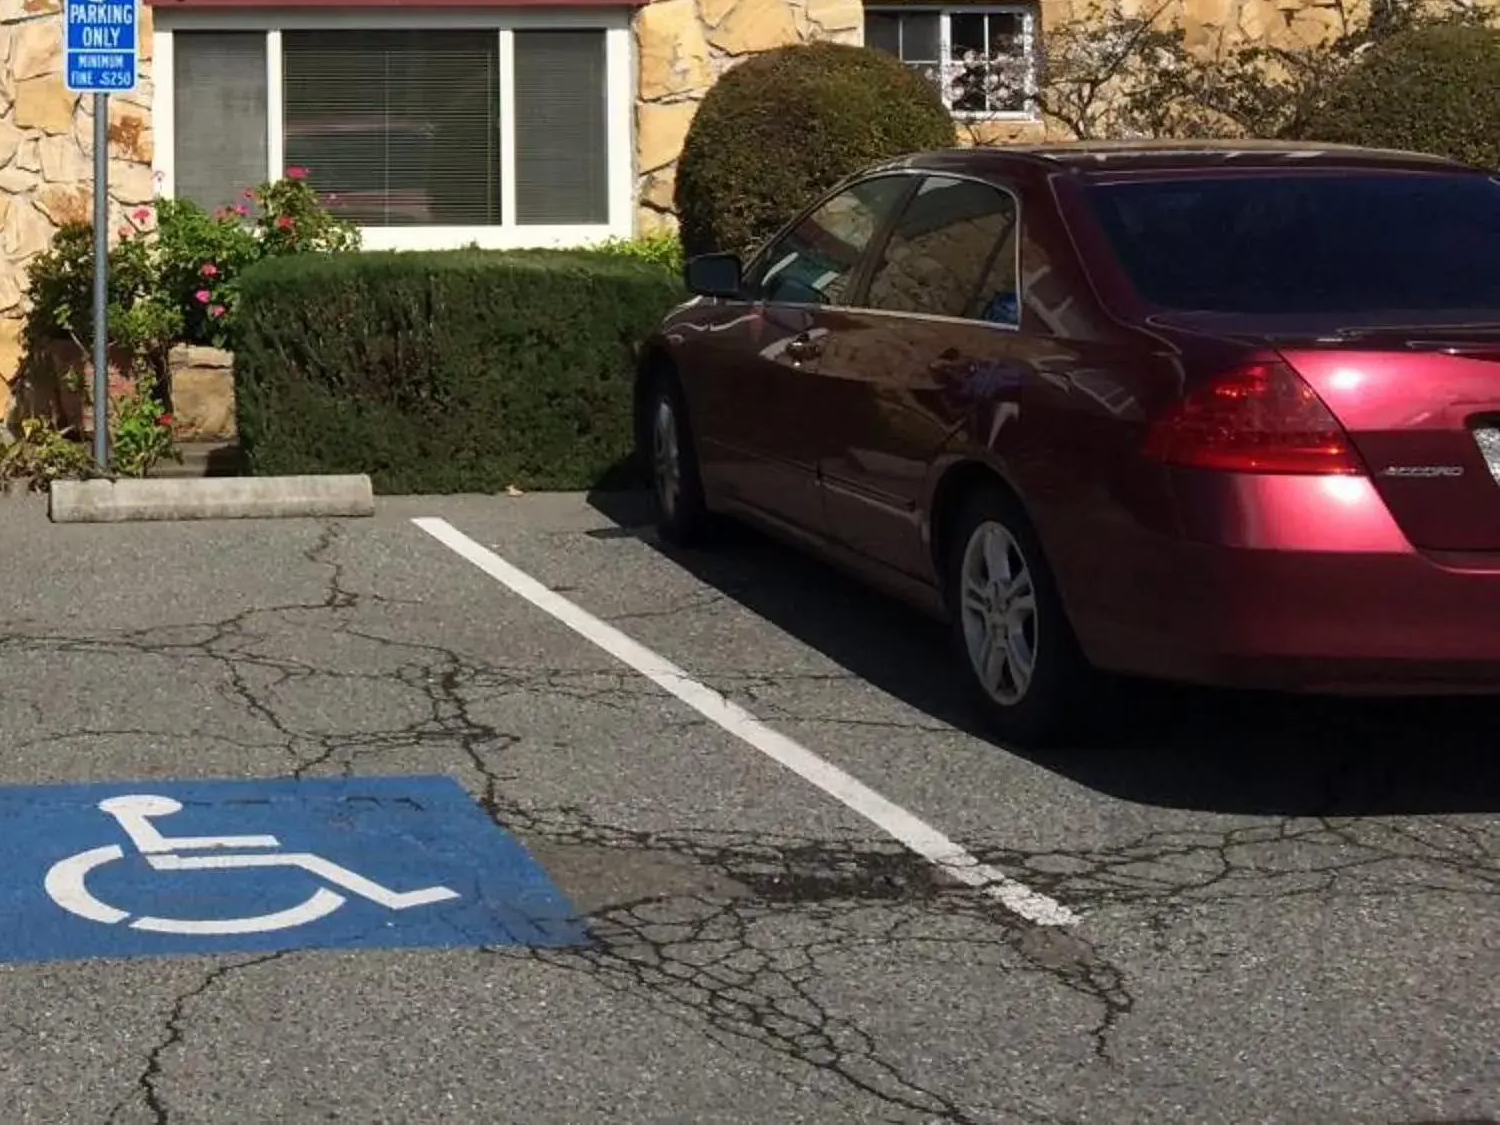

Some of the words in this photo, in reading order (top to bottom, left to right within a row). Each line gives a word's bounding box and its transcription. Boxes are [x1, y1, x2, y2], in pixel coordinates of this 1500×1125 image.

[69, 4, 133, 25] PARKING
[82, 26, 121, 48] ONLY
[77, 54, 124, 69] MINIMUM
[71, 70, 94, 86] FINE
